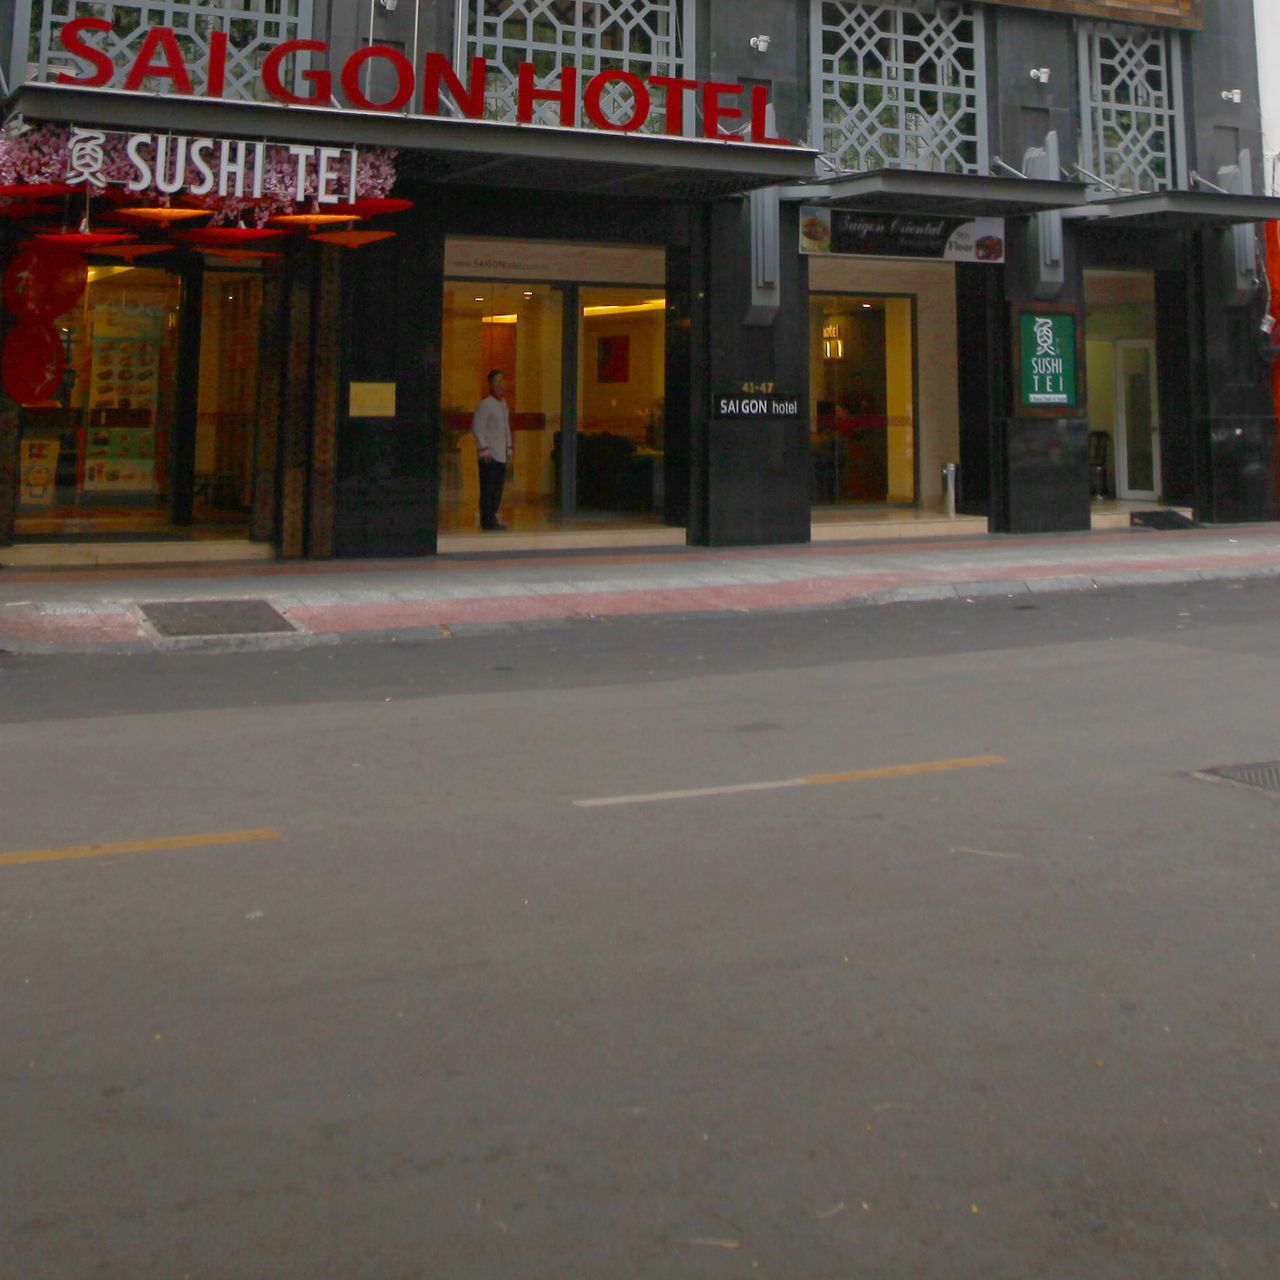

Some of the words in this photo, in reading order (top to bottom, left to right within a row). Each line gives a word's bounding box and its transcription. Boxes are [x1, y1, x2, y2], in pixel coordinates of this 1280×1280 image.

[55, 18, 228, 97] SAI
[261, 38, 487, 119] GON
[519, 62, 792, 147] HOTEL
[126, 134, 266, 199] SUSHI
[289, 144, 359, 205] TEI
[948, 241, 974, 253] Floor
[1031, 357, 1063, 374] SUSHI
[772, 400, 798, 415] hotel
